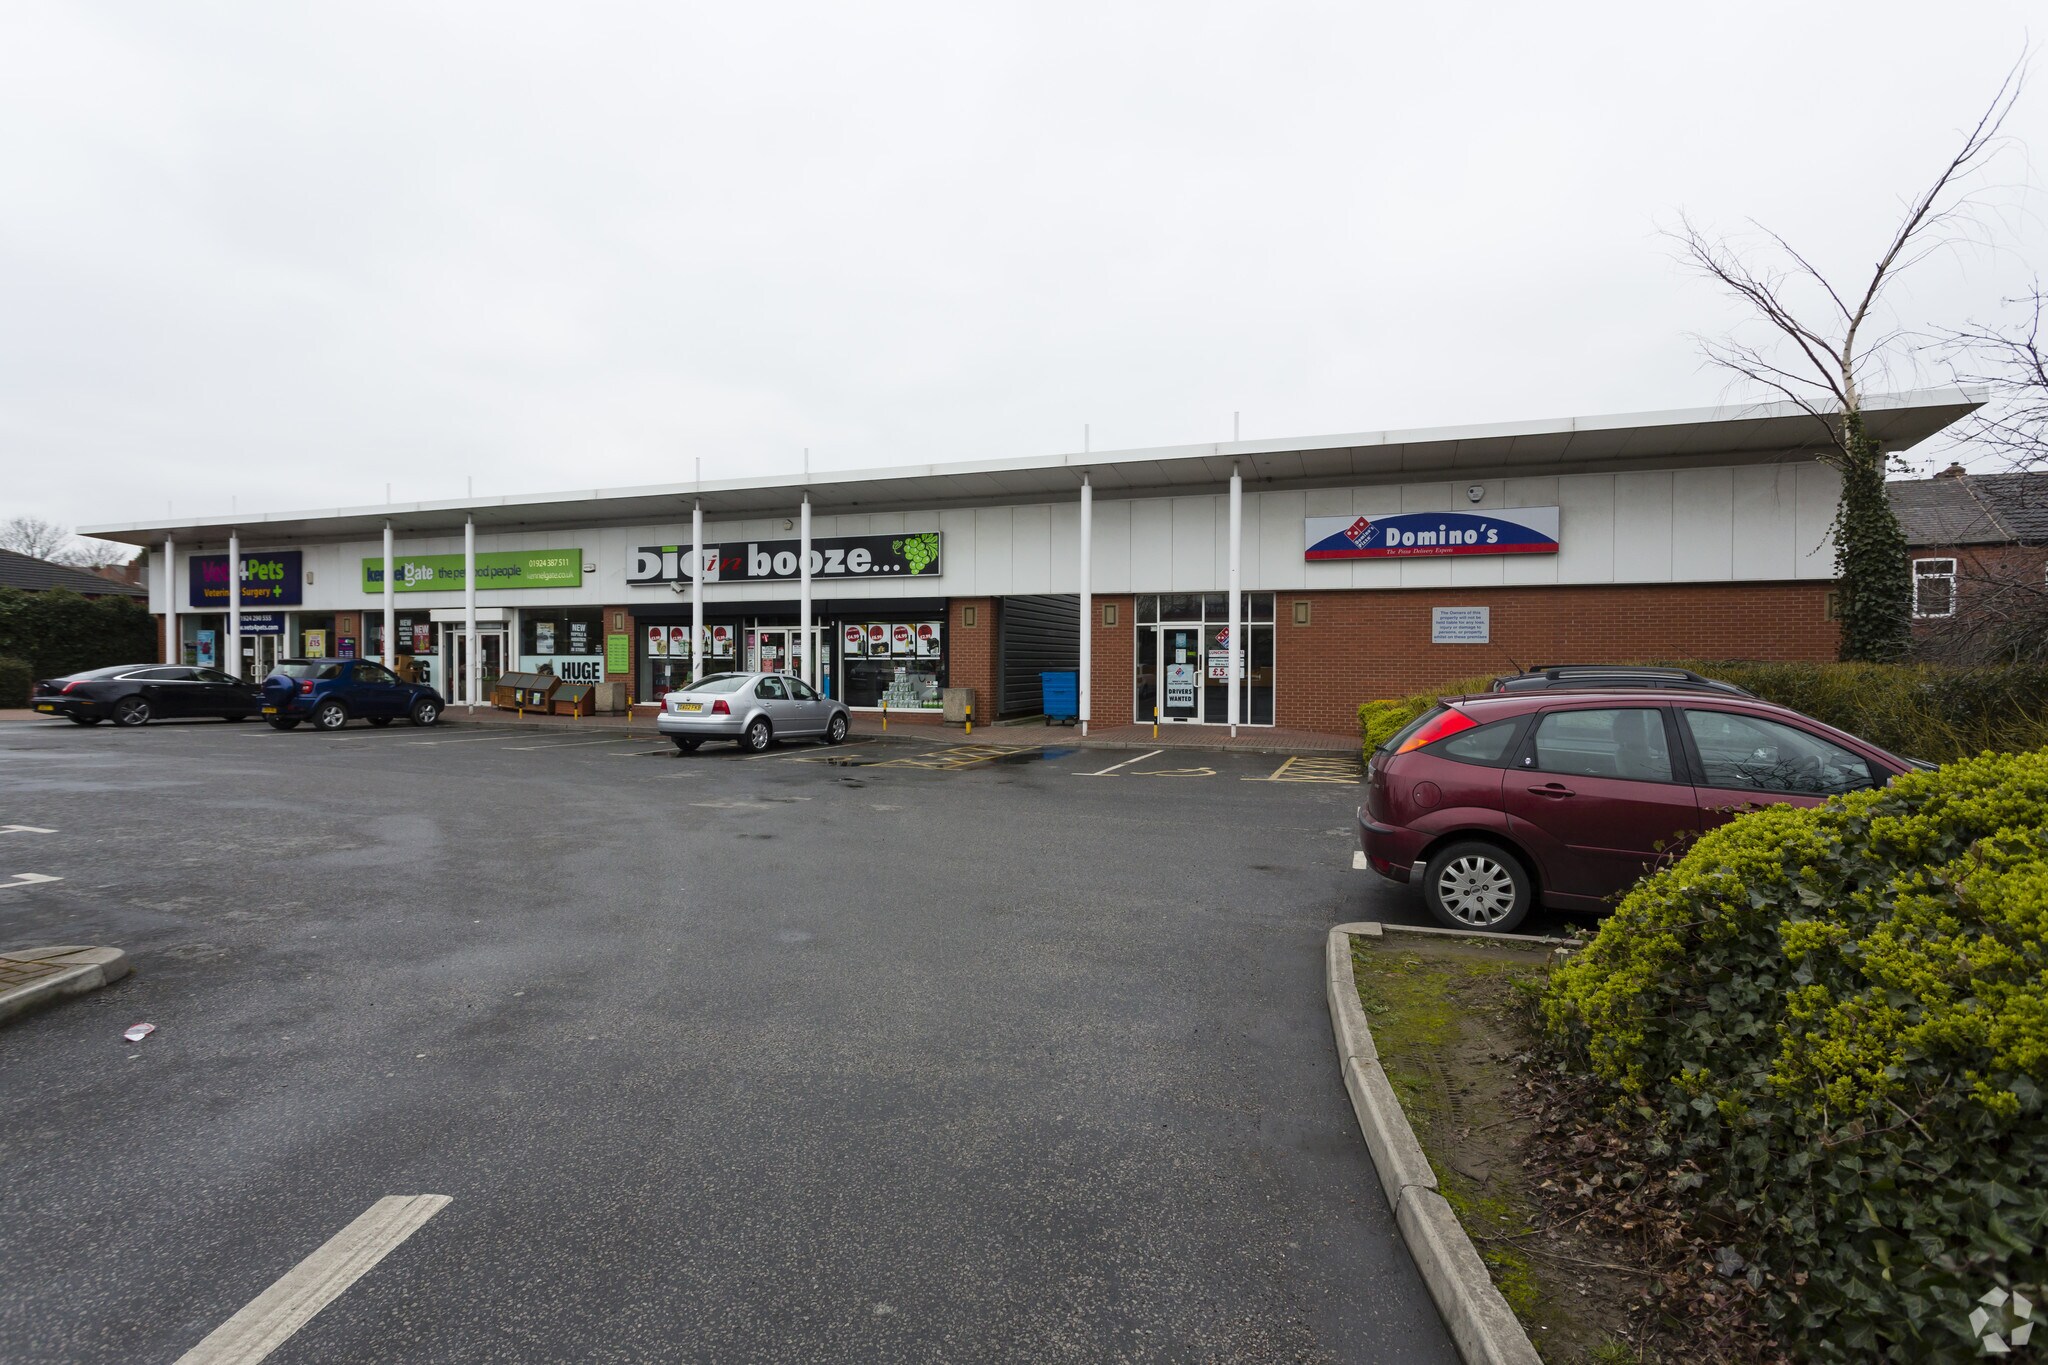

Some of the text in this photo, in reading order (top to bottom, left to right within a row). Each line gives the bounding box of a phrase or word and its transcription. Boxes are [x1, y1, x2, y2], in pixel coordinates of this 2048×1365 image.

[1385, 524, 1498, 547] Domino's
[528, 558, 569, 568] 01924 387 511
[626, 545, 720, 582] big
[747, 543, 900, 576] booze...
[202, 559, 284, 582] Vet4Pets
[367, 562, 433, 587] kenelgate
[439, 567, 452, 579] the
[474, 565, 489, 577] ood
[491, 564, 522, 579] people
[526, 571, 573, 581] kennelgate.co.uk
[203, 587, 270, 598] Veterin Surgery
[414, 624, 430, 634] NEW
[572, 623, 586, 632] NEW
[561, 662, 600, 680] HUGE
